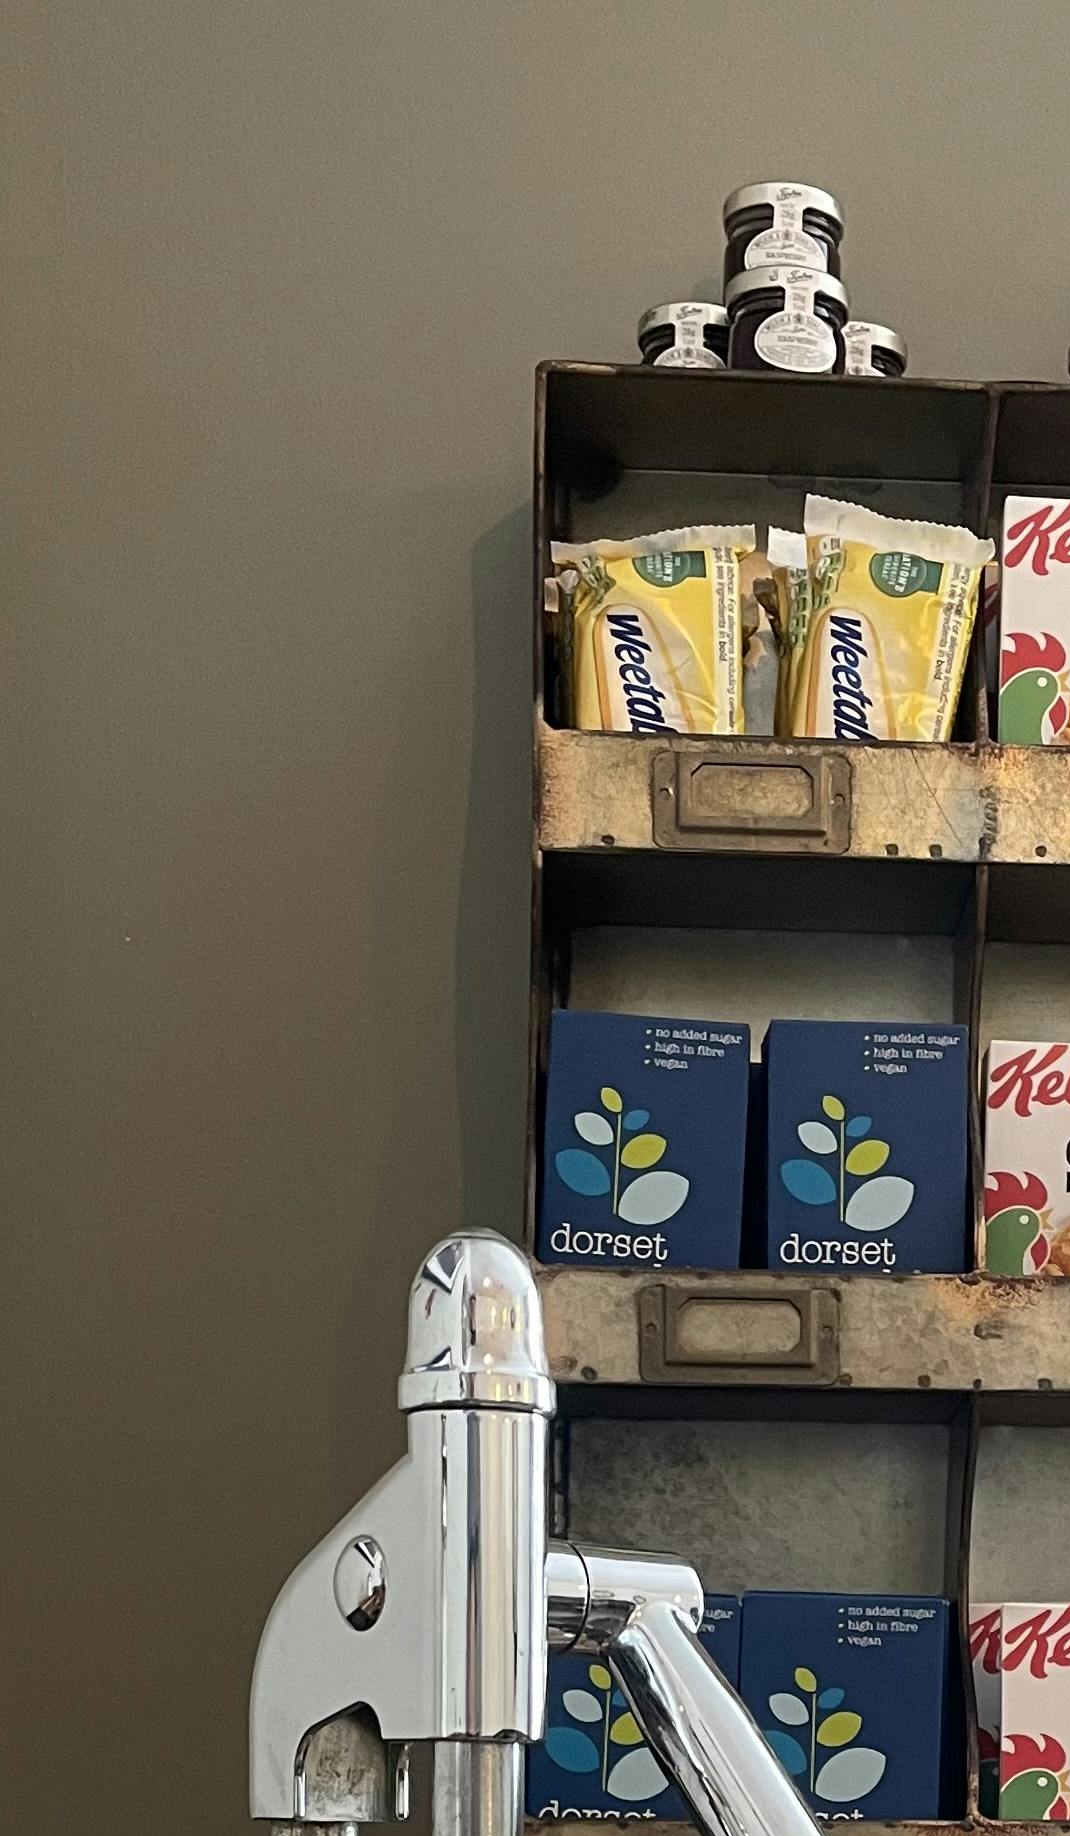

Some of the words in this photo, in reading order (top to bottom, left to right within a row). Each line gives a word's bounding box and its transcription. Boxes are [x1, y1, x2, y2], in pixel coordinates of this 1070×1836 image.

[656, 1027, 670, 1039] no
[672, 1028, 707, 1041] added
[709, 1031, 743, 1045] sugar
[873, 1033, 888, 1044] no
[890, 1033, 924, 1045] added
[928, 1033, 960, 1047] sugar
[654, 1041, 679, 1055] high
[682, 1043, 694, 1055] in
[697, 1045, 725, 1058] fibre
[873, 1047, 898, 1060] high
[901, 1048, 912, 1059] in
[654, 1057, 688, 1070] vegan
[873, 1063, 907, 1074] vegan
[550, 1223, 668, 1261] dorset
[779, 1233, 895, 1266] dorset
[848, 1606, 863, 1617] no
[866, 1606, 899, 1618] added
[902, 1607, 936, 1620] sugar
[847, 1620, 873, 1633] high
[876, 1621, 888, 1632] in
[847, 1635, 882, 1647] vegan
